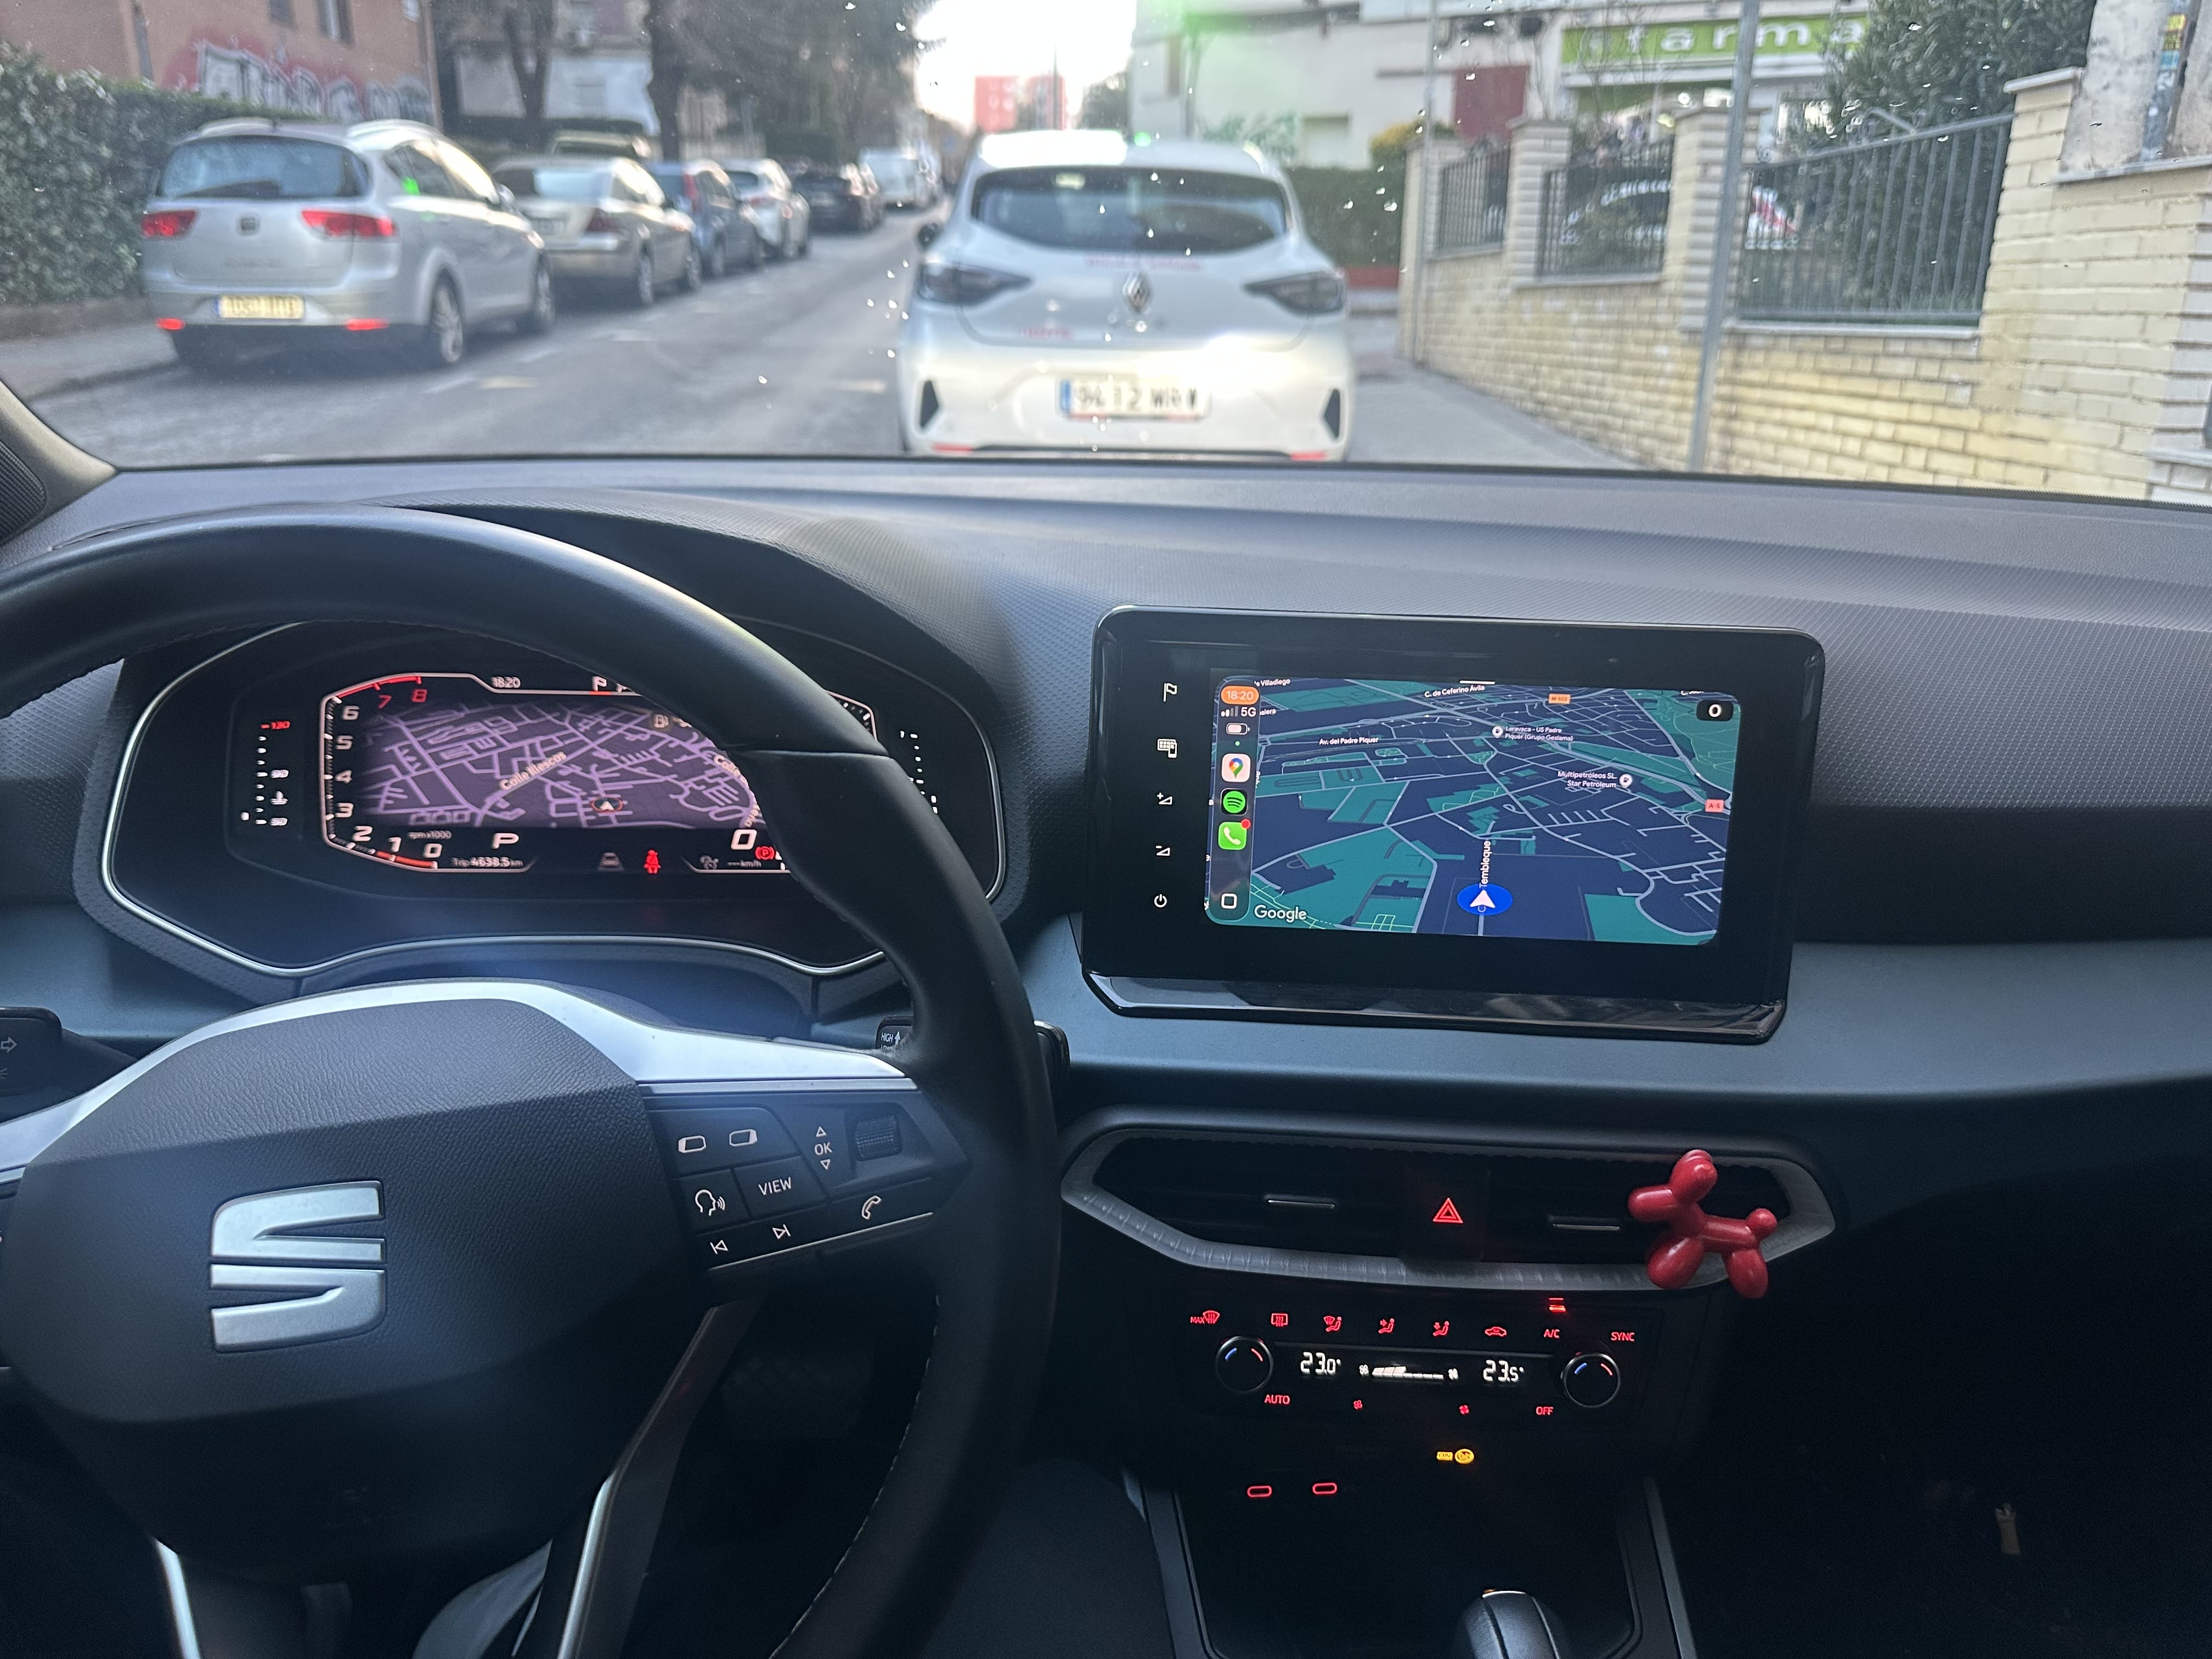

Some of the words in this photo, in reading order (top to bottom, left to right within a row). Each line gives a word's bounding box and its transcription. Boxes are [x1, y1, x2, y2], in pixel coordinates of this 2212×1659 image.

[592, 676, 607, 691] P
[378, 695, 391, 708] 7
[412, 689, 427, 702] 8
[1226, 690, 1254, 701] 18:20
[342, 706, 359, 720] 6
[1240, 707, 1256, 717] 5G
[336, 735, 353, 749] 5
[335, 770, 352, 783] 4
[499, 771, 531, 791] Calle
[335, 803, 354, 817] 3
[353, 826, 373, 841] 2
[731, 829, 757, 850] 0
[388, 837, 402, 852] 1
[492, 833, 519, 849] P
[424, 843, 443, 859] 0
[1254, 904, 1307, 923] Google
[881, 1032, 894, 1043] HIGH
[814, 1142, 832, 1155] OK
[758, 1177, 792, 1195] VIEW
[1190, 1316, 1205, 1324] MAX
[1543, 1329, 1560, 1339] A/C
[1611, 1332, 1635, 1342] SYNC
[1264, 1394, 1290, 1405] AUTO
[1536, 1406, 1554, 1415] OFF
